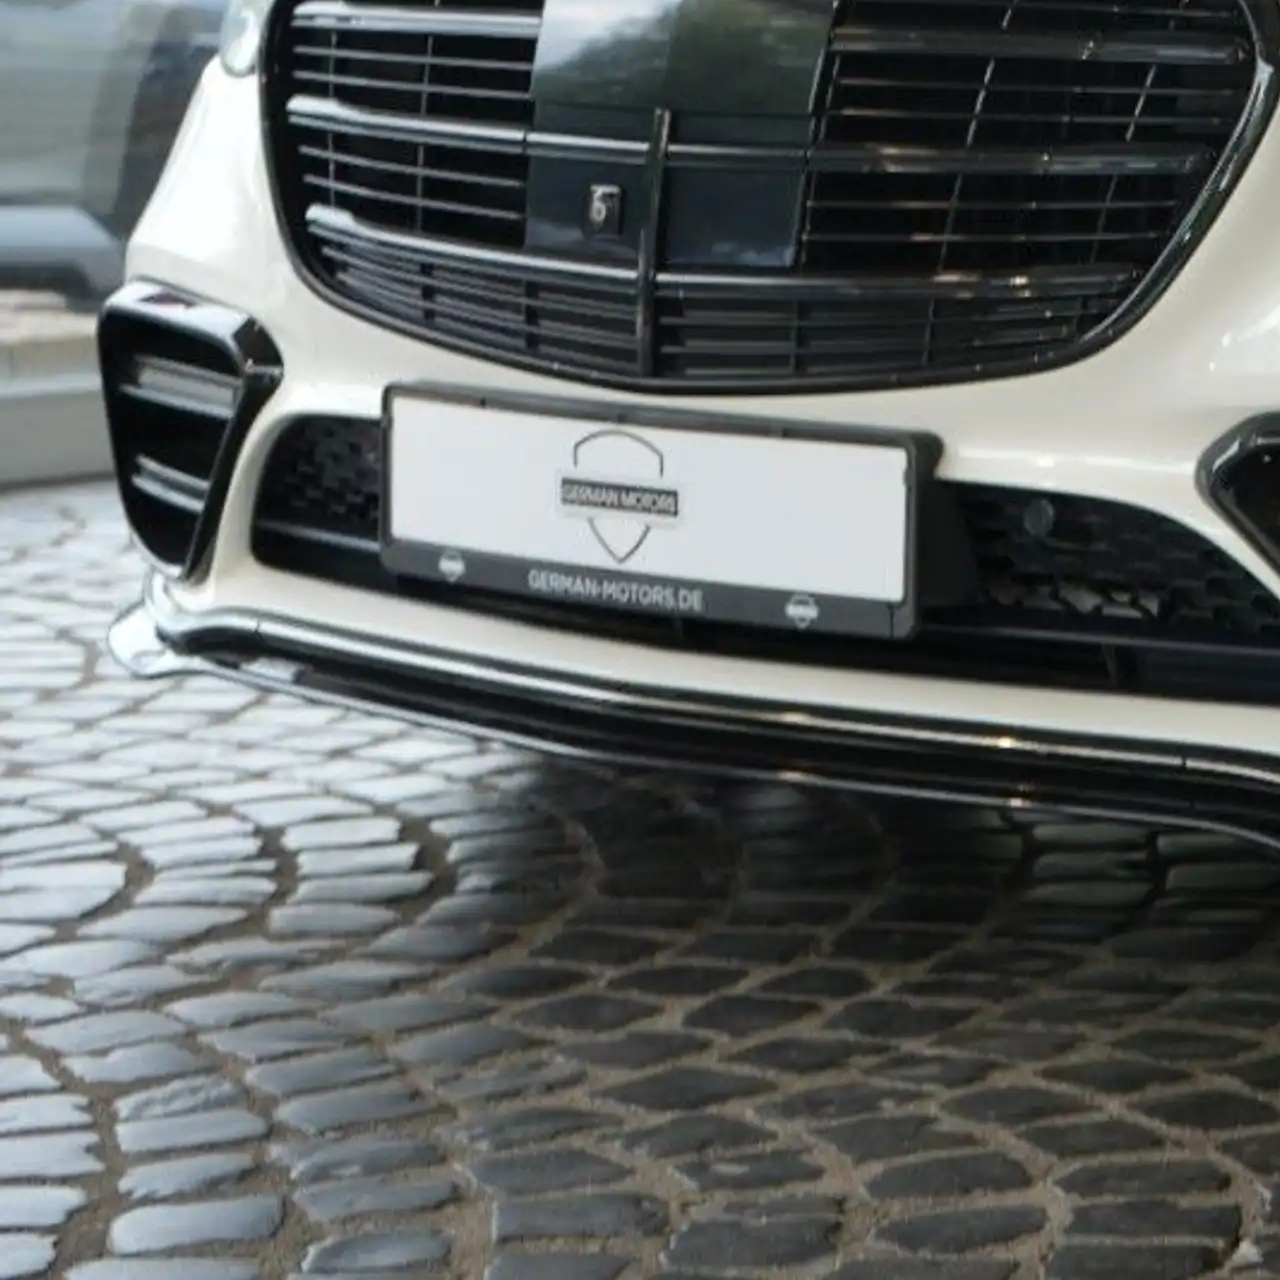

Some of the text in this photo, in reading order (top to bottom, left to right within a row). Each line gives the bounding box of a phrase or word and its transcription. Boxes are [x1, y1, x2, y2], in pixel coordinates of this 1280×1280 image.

[561, 482, 676, 514] GERMAN MOTORS
[527, 569, 703, 611] GERMAN-MOTORS.DE
